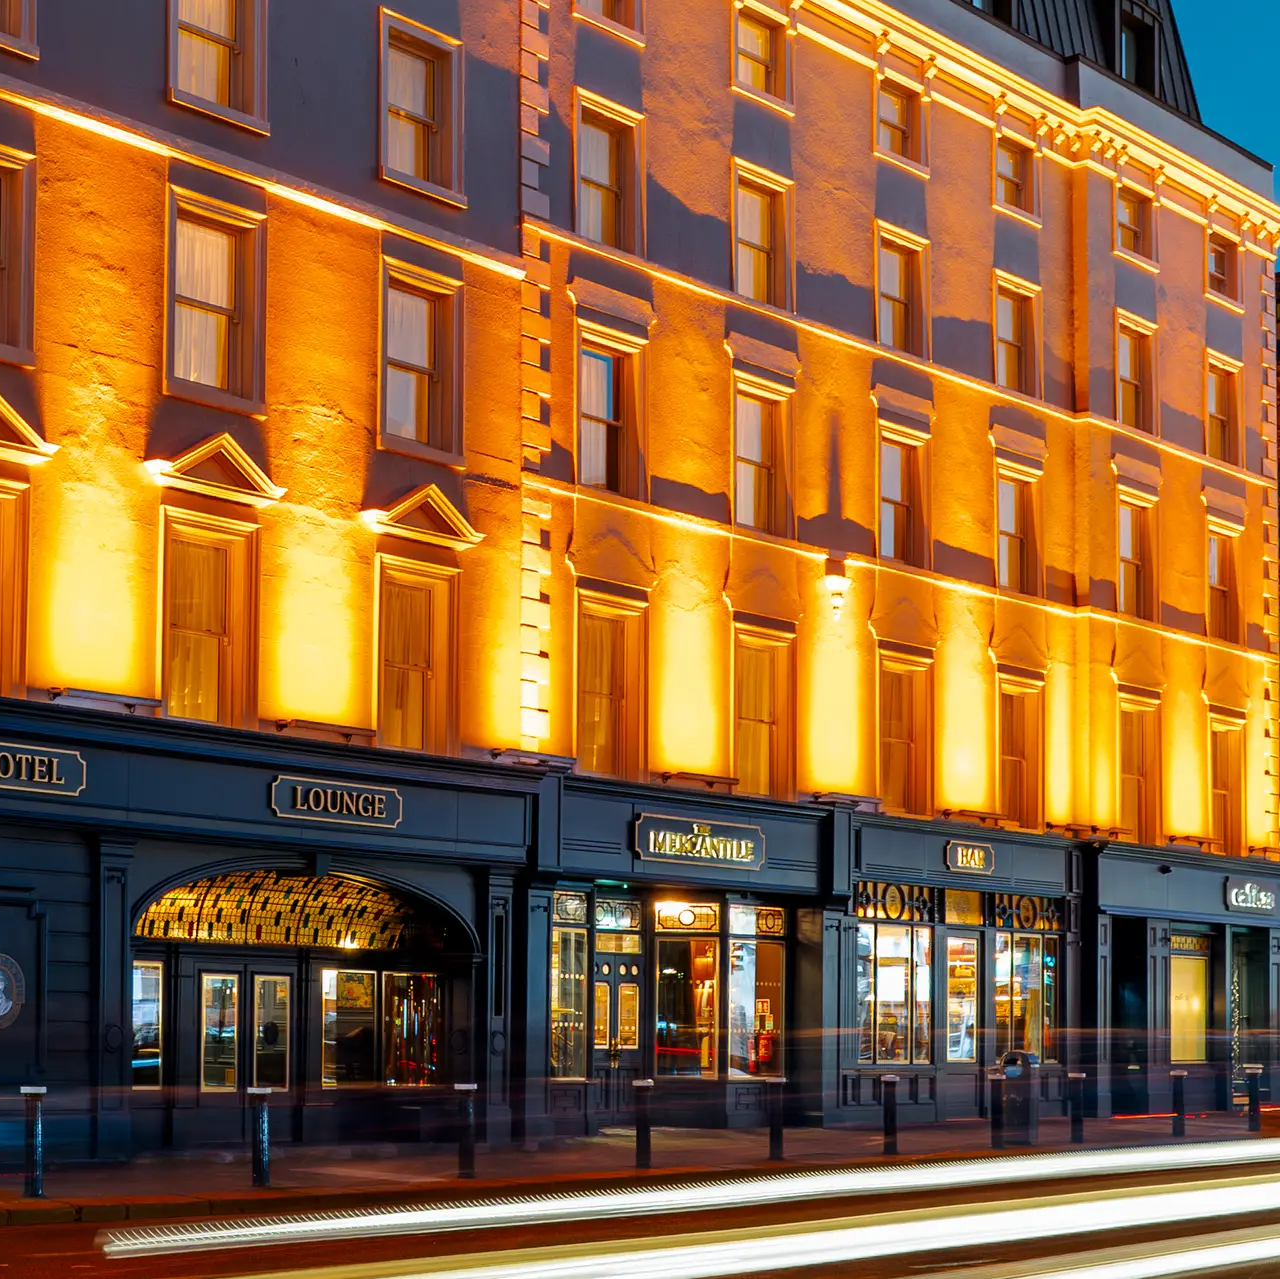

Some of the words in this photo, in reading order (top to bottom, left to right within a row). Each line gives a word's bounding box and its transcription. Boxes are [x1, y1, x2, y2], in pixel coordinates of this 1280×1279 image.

[295, 785, 386, 818] LOUNGE
[648, 830, 755, 862] MERCANTILE
[957, 846, 986, 868] BAR
